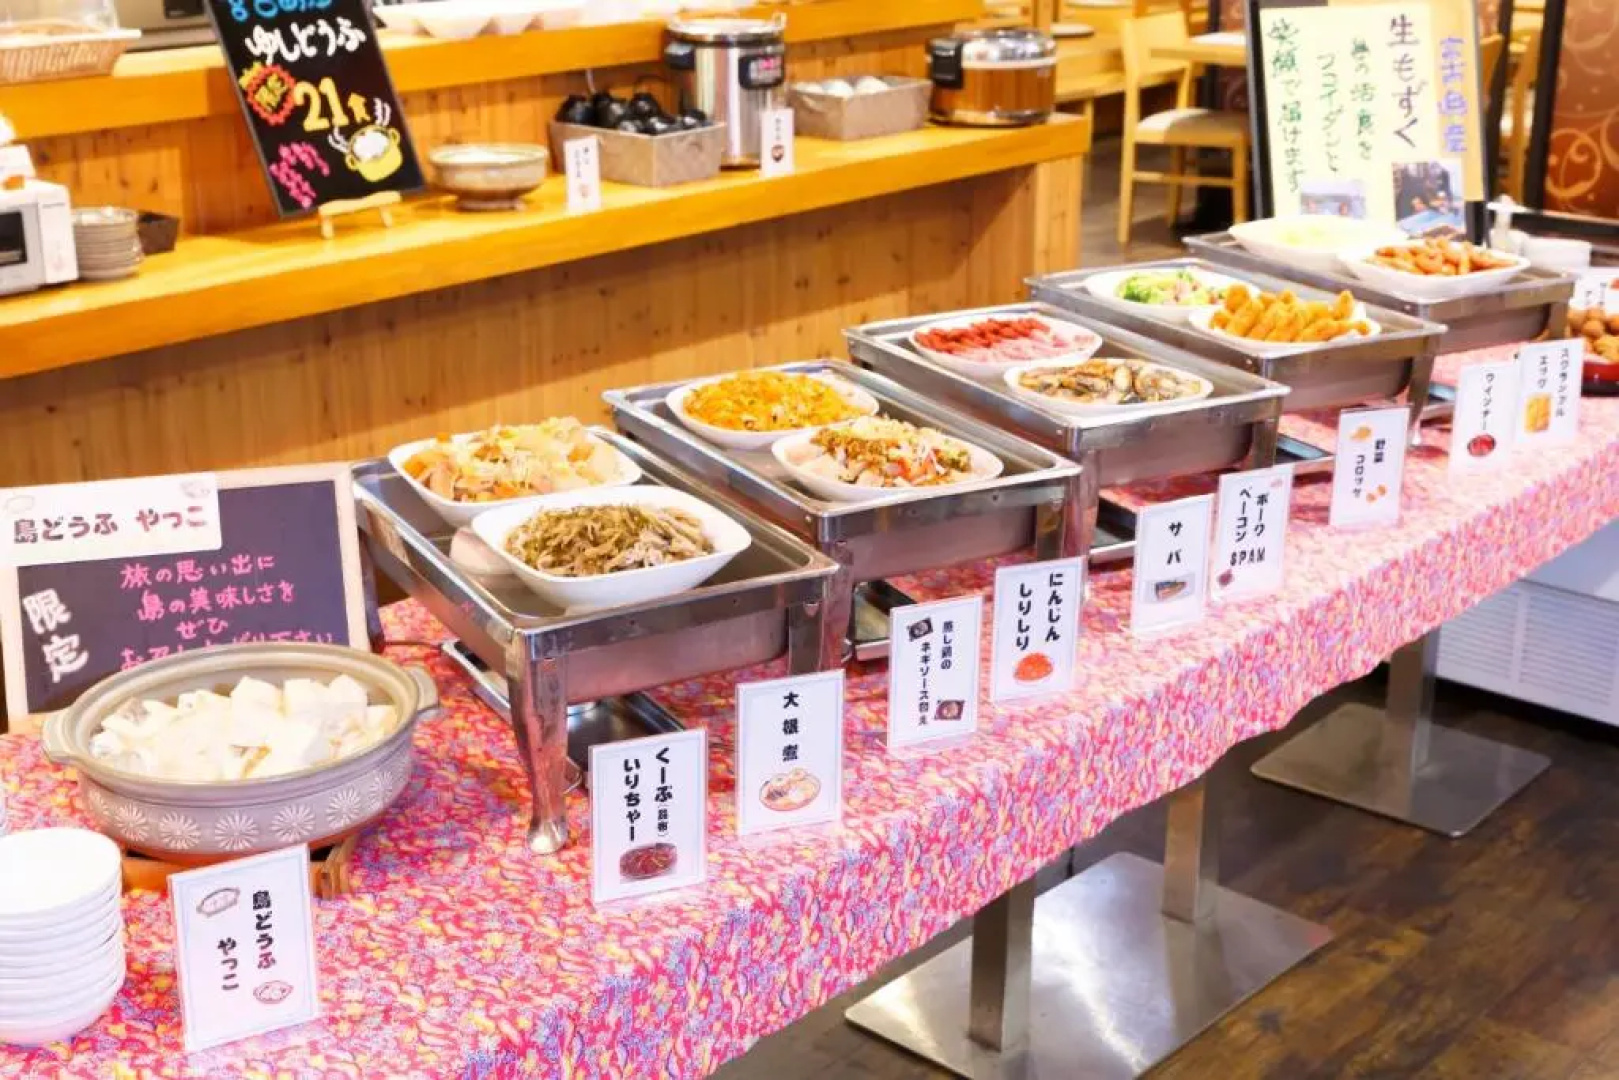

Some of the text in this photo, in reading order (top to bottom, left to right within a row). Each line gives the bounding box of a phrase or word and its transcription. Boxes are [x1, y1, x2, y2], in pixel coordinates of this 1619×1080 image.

[1388, 13, 1428, 148] 生もずく
[1353, 454, 1366, 498] コロッケ
[14, 505, 208, 544] 島どうふ やっこ
[1235, 486, 1252, 543] ベーコン
[1254, 492, 1270, 537] ポーク
[1166, 521, 1183, 566] サバ
[1230, 547, 1266, 566] SPAM
[120, 554, 275, 590] 旅の思い出に
[137, 580, 296, 622] 島の美味しさを
[176, 616, 229, 640] ぜひ
[1015, 582, 1032, 651] しりしり
[1045, 572, 1064, 643] にんじん
[23, 588, 90, 684] 限定
[782, 691, 799, 762] 大根煮
[624, 758, 641, 842] いりちゃー
[252, 890, 276, 969] 島どうふ
[217, 937, 240, 991] やっこ
